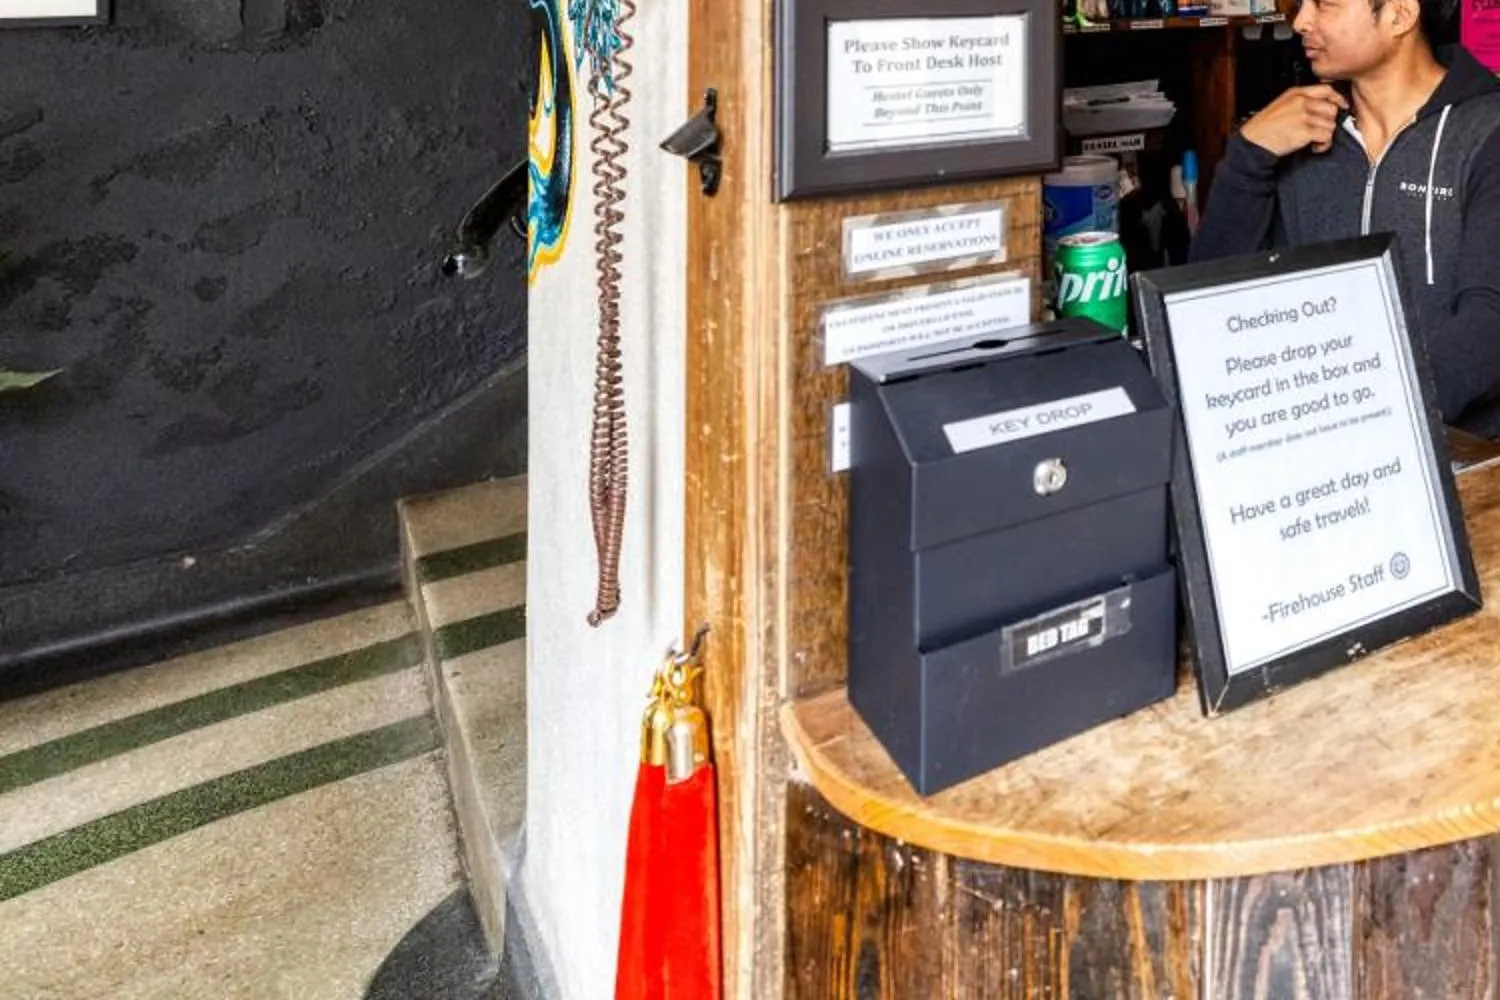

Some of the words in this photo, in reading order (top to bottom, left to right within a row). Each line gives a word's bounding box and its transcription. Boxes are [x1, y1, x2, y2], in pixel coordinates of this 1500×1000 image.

[844, 38, 898, 53] Please
[902, 34, 945, 50] Show
[949, 33, 1009, 50] Keycard
[851, 60, 873, 74] To
[877, 58, 921, 72] Front
[926, 54, 964, 69] Desk
[969, 53, 1003, 68] Host
[957, 85, 984, 99] Only
[1400, 181, 1453, 197] BONIRE
[873, 230, 892, 242] WE
[896, 224, 931, 238] ONLY
[934, 218, 982, 233] ACCEPT
[854, 248, 903, 264] ONLINE
[906, 235, 998, 256] RESERVATIONS
[1058, 254, 1127, 309] prit
[1226, 307, 1299, 333] Checking
[1301, 296, 1337, 317] Out?
[1226, 353, 1278, 375] Please
[1281, 345, 1317, 361] drop
[1320, 335, 1353, 357] your
[1205, 378, 1272, 410] keycard
[1275, 377, 1291, 392] in
[1293, 370, 1319, 389] the
[1321, 363, 1349, 381] box
[1352, 352, 1381, 373] and
[989, 413, 1033, 436] KEY
[1035, 402, 1093, 425] DROP
[1225, 417, 1257, 440] you
[1261, 408, 1288, 426] are
[1291, 393, 1330, 420] good
[1332, 392, 1349, 407] to
[1352, 386, 1376, 404] go.
[1229, 500, 1276, 525] Have
[1279, 495, 1292, 509] a
[1295, 479, 1339, 507] great
[1341, 471, 1369, 490] day
[1373, 456, 1402, 480] and
[1279, 517, 1312, 541] safe
[1315, 496, 1371, 529] travels!
[1262, 583, 1346, 623] -Firehouse
[1349, 563, 1385, 593] Staff
